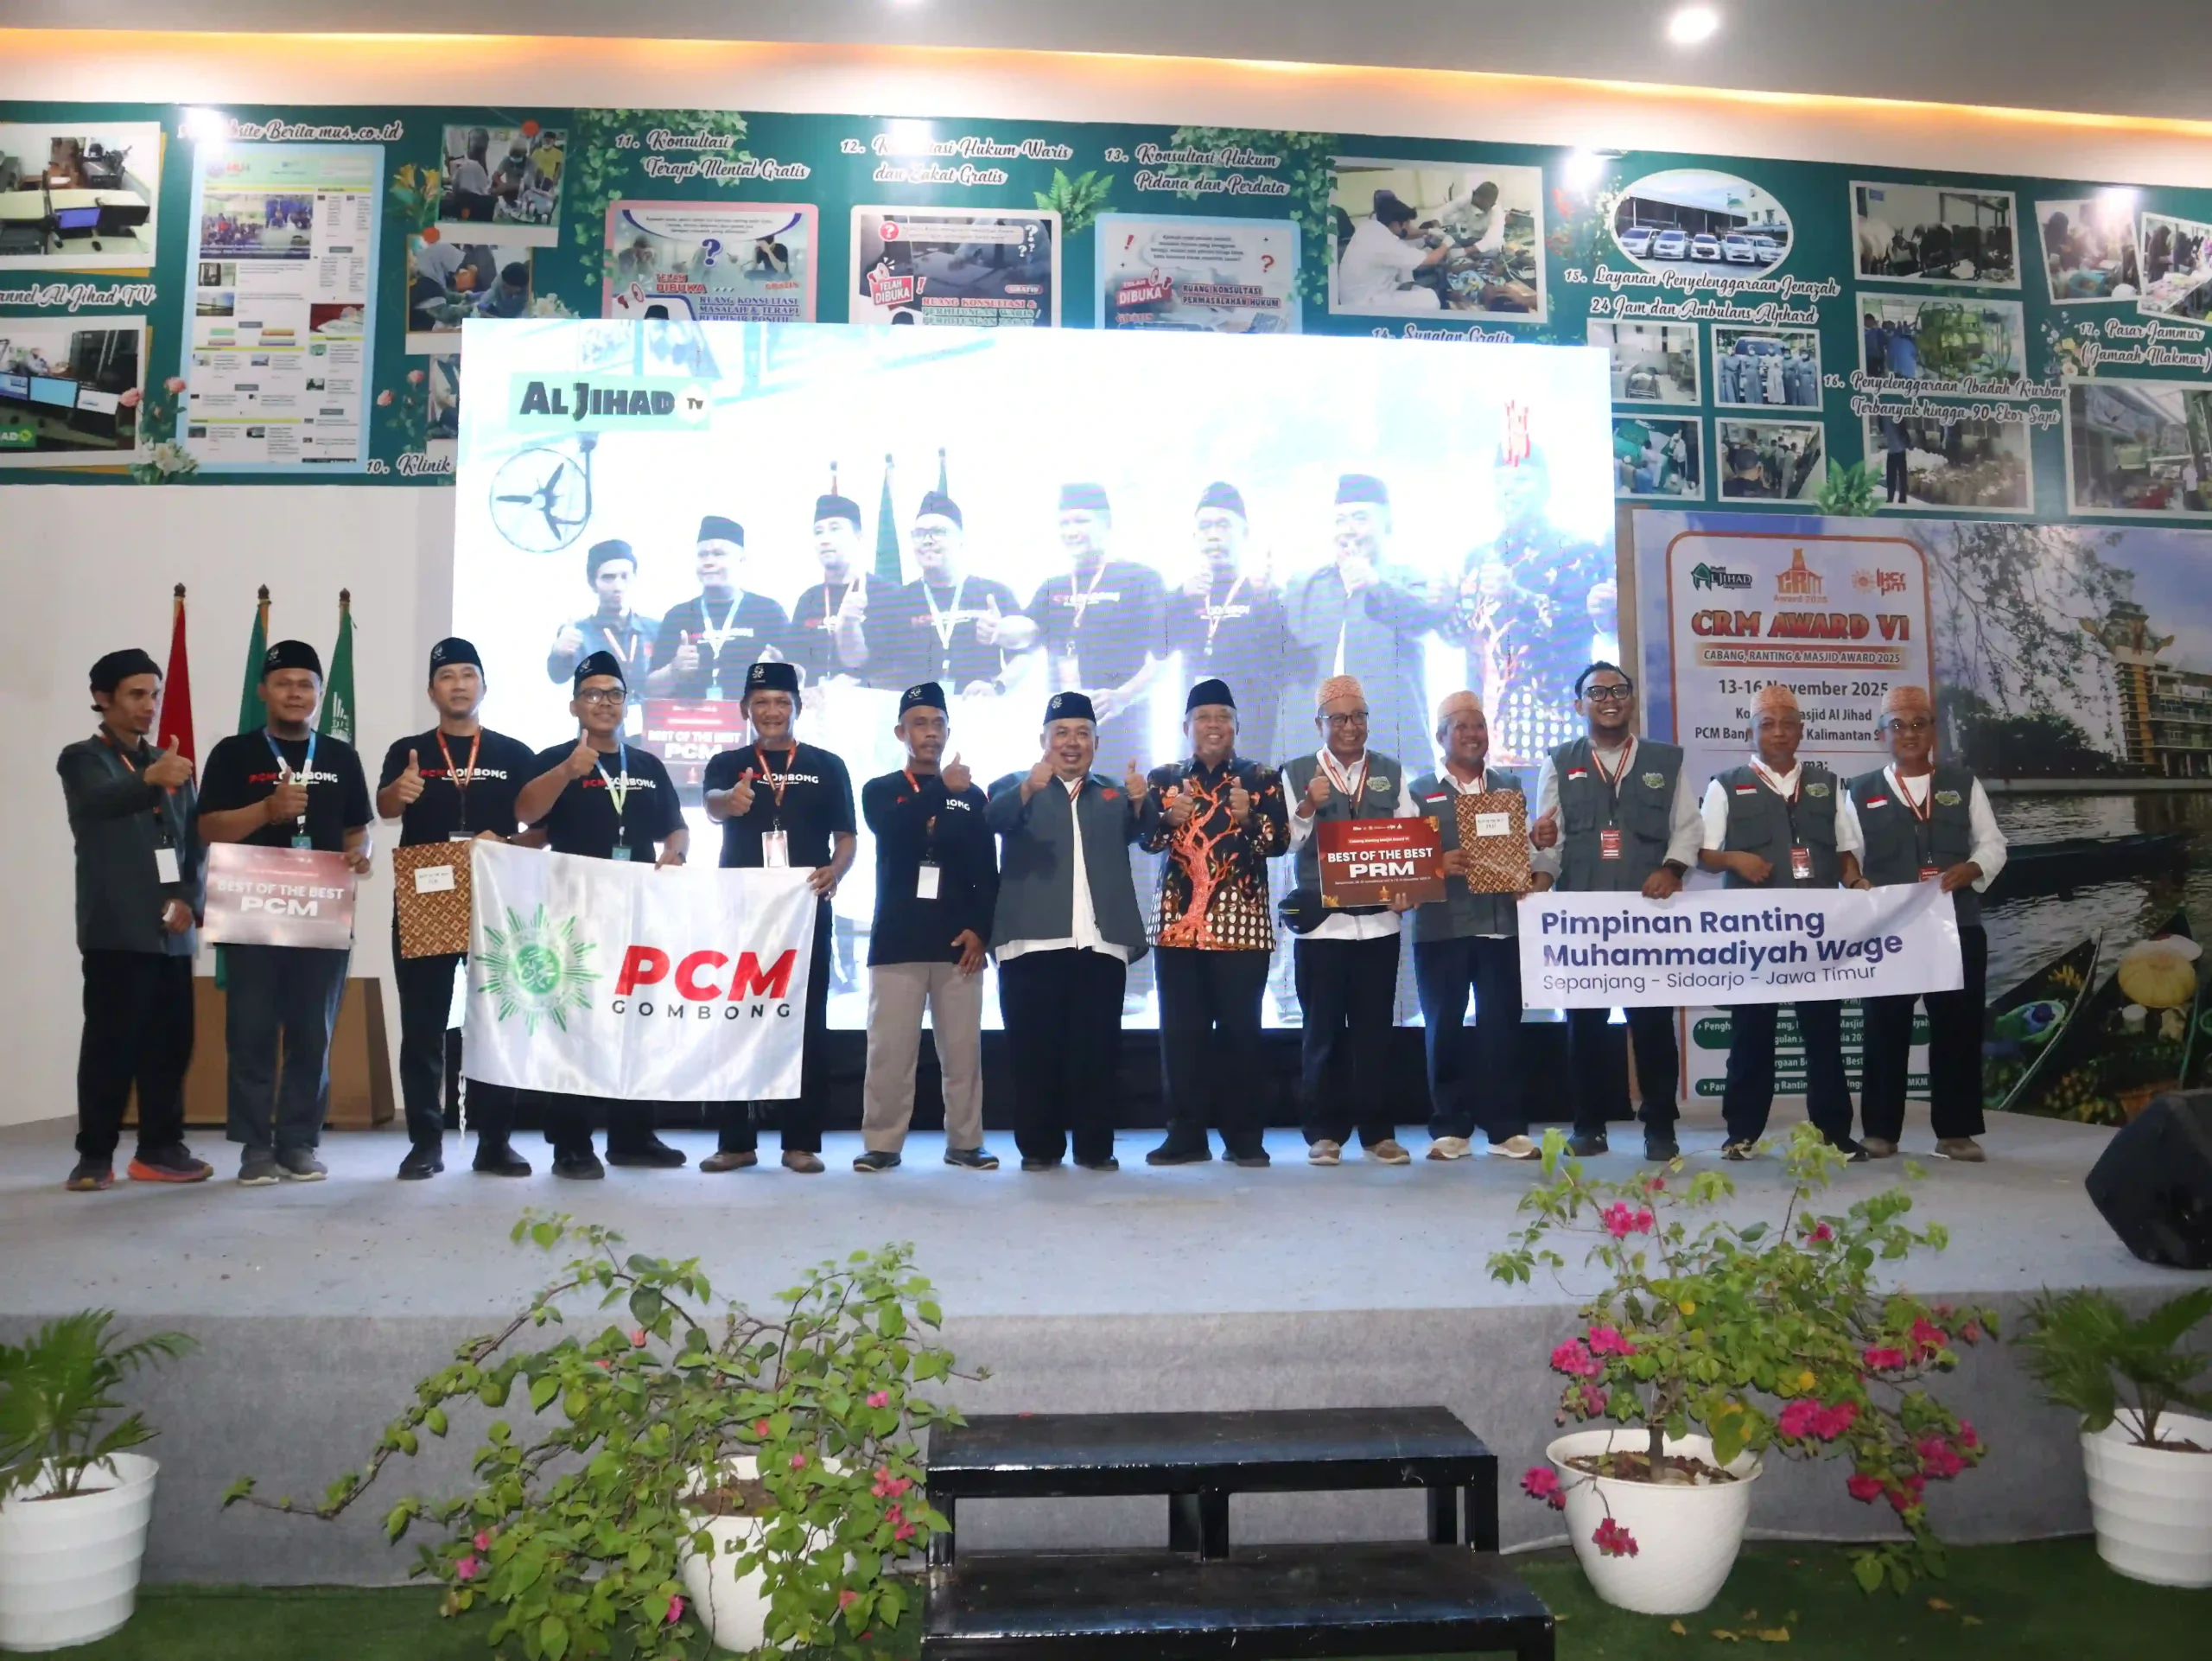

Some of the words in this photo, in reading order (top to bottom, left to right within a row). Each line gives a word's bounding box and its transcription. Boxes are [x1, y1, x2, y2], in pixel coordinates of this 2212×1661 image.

[618, 136, 639, 148] 11.
[649, 131, 730, 149] Konsultasi
[842, 141, 864, 152] 12.
[959, 138, 1016, 156] Hukum
[1021, 140, 1068, 157] Waris
[1106, 150, 1128, 161] 13.
[1136, 144, 1215, 165] Konsultasi
[1221, 148, 1278, 167] Hukum
[646, 157, 694, 182] Terapi
[701, 158, 756, 177] Mental
[761, 161, 805, 179] Gratis
[875, 162, 904, 180] dan
[960, 165, 1003, 182] Gratis
[1135, 171, 1191, 189] Pidana
[1194, 175, 1222, 190] dan
[1227, 175, 1286, 194] Perdata
[880, 279, 902, 291] TELAH
[1182, 284, 1210, 294] RUANG
[1212, 285, 1262, 295] KONSULTASI
[1566, 270, 1586, 283] 15.
[1595, 268, 1656, 289] Layanan
[1662, 270, 1777, 294] Penyelenggaraan
[1782, 276, 1837, 300] Jenazah
[39, 285, 65, 305] Al
[70, 286, 117, 309] Jihad
[874, 289, 912, 304] DIBUKA
[1119, 287, 1163, 305] DIBUKA
[1182, 296, 1248, 306] PERMASALAHAN
[1249, 298, 1280, 307] HUKUM
[1592, 298, 1608, 312] 24
[1614, 297, 1645, 315] Jam
[1650, 298, 1675, 314] dan
[1681, 300, 1751, 318] Ambulans
[1754, 304, 1815, 323] Alphard
[1406, 325, 1463, 341] Sunatan
[1469, 327, 1510, 343] Gratis
[2107, 320, 2144, 337] Pasar
[2147, 321, 2202, 344] Jammur
[2081, 342, 2142, 366] (Jamaah
[2146, 347, 2211, 371] Makmur)
[1824, 375, 1844, 387] 16.
[1851, 372, 1958, 397] Penyelenggaraan
[1963, 378, 2011, 395] Ibadah
[2016, 380, 2067, 398] Kurban
[519, 381, 569, 415] AL
[572, 382, 675, 422] JIHAD
[1851, 398, 1919, 423] Terbanyak
[1923, 400, 1966, 425] hingga
[1974, 405, 1990, 420] 90
[1995, 404, 2024, 422] Ekor
[2030, 405, 2058, 430] Sapi
[367, 461, 388, 472] 10.
[398, 454, 450, 474] Klinik
[1691, 609, 1763, 638] CRM
[1767, 611, 1871, 640] AWARD
[1876, 614, 1910, 641] VI
[1704, 649, 1749, 662] CABANG,
[1749, 651, 1796, 662] RANTING
[1803, 652, 1839, 663] MASJID
[1840, 652, 1876, 663] AWARD
[1878, 652, 1901, 664] 2025
[1719, 679, 1762, 695] 13-16
[1766, 680, 1847, 697] vember
[1852, 681, 1889, 697] 2025
[1800, 707, 1826, 723] asjid
[1828, 709, 1840, 720] Al
[1842, 709, 1872, 722] Jihad
[1695, 728, 1719, 739] PCM
[1807, 729, 1872, 741] Kalimantan
[664, 743, 722, 759] PCM
[1327, 851, 1357, 862] BEST
[1360, 850, 1376, 862] OF
[1378, 849, 1402, 861] THE
[1404, 847, 1433, 859] BEST
[1349, 861, 1415, 878] PRM
[218, 881, 252, 893] BEST
[256, 882, 276, 894] OF
[279, 884, 306, 897] THE
[308, 886, 345, 900] BEST
[241, 894, 318, 917] PCM
[1541, 910, 1692, 941] Pimpinan
[1700, 907, 1825, 938] Ranting
[1543, 939, 1808, 971] Muhammadiyah
[1817, 932, 1904, 964] Wage
[614, 945, 798, 1002] PCM
[1543, 973, 1645, 994] Sepanjang
[1667, 971, 1745, 992] Sidoarjo
[1766, 969, 1816, 987] Jawa
[1823, 965, 1877, 983] Timur
[612, 1000, 791, 1021] GOMBONG
